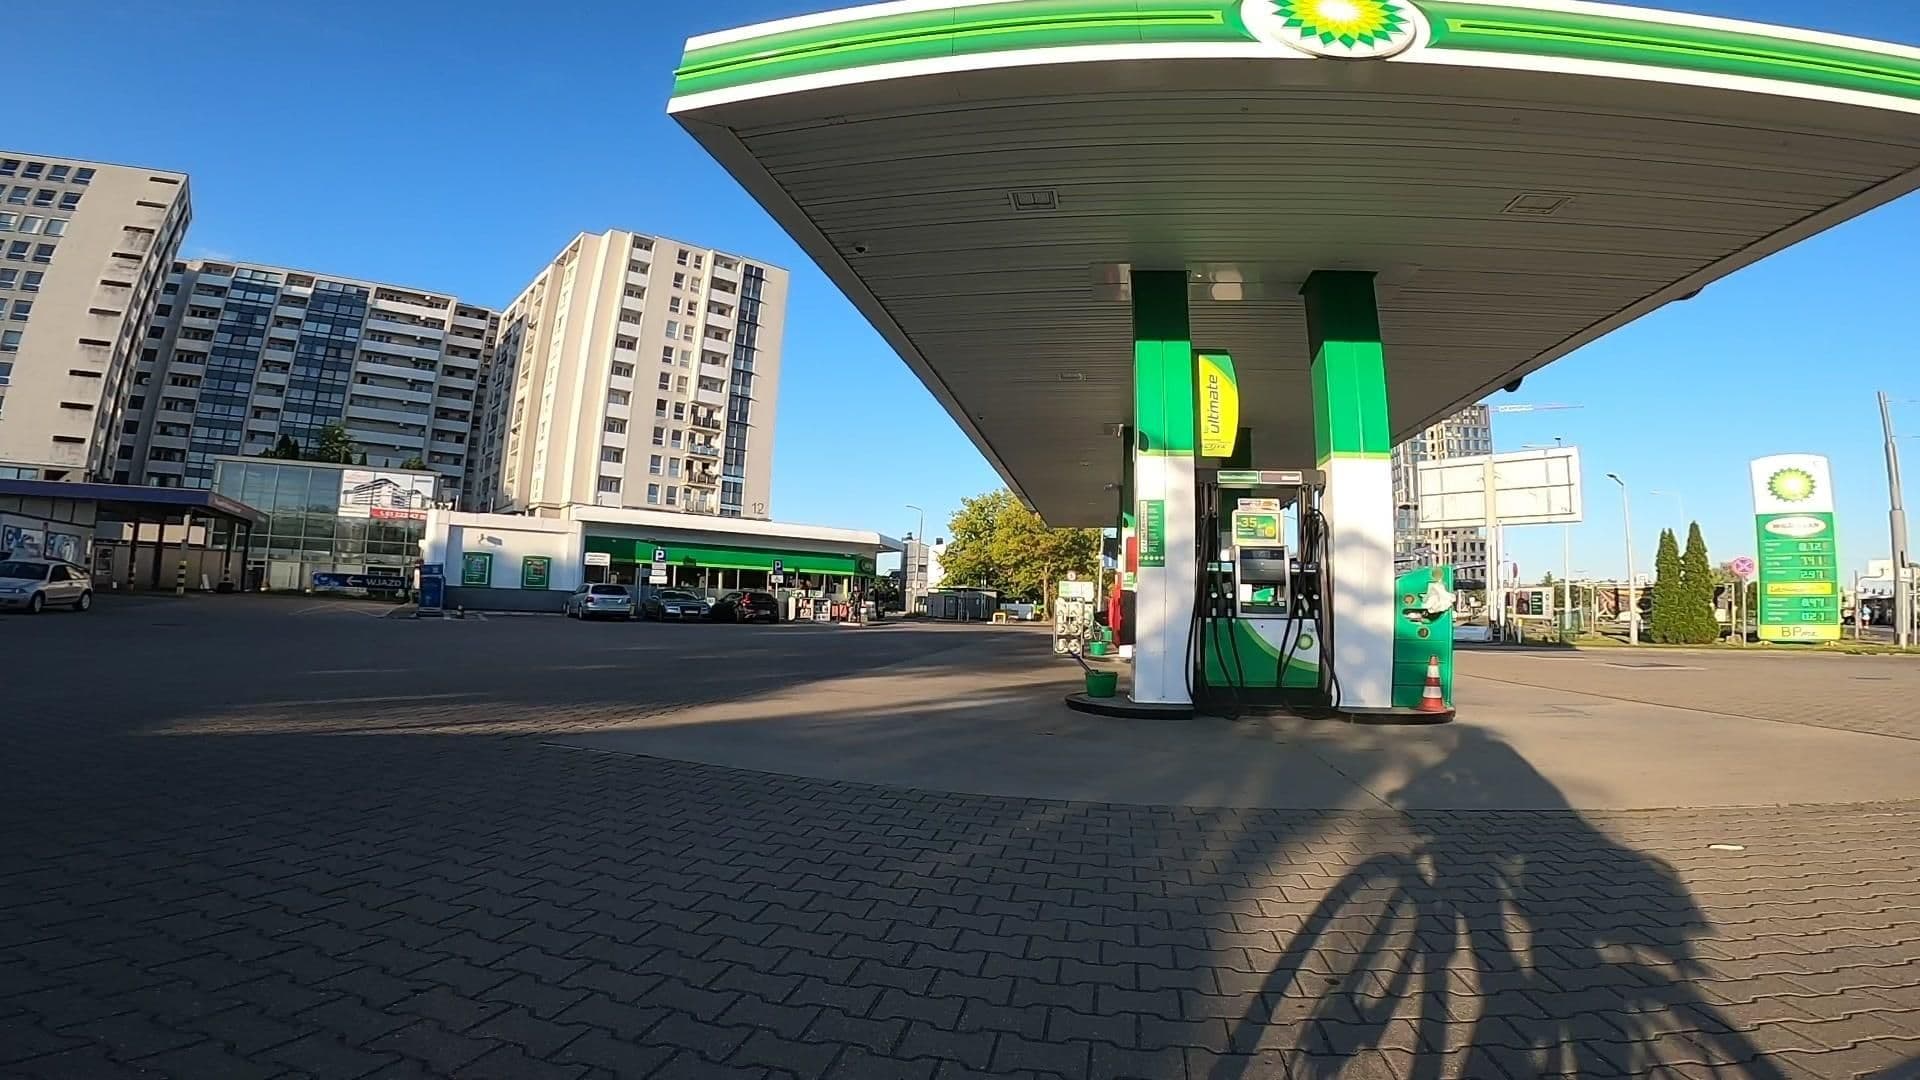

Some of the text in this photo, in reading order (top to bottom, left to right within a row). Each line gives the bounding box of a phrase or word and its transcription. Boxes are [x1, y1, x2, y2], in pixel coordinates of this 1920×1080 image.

[1207, 374, 1220, 434] ultimate
[752, 502, 764, 514] 12
[655, 550, 665, 561] P
[775, 560, 781, 570] P
[366, 578, 402, 587] WJAZD
